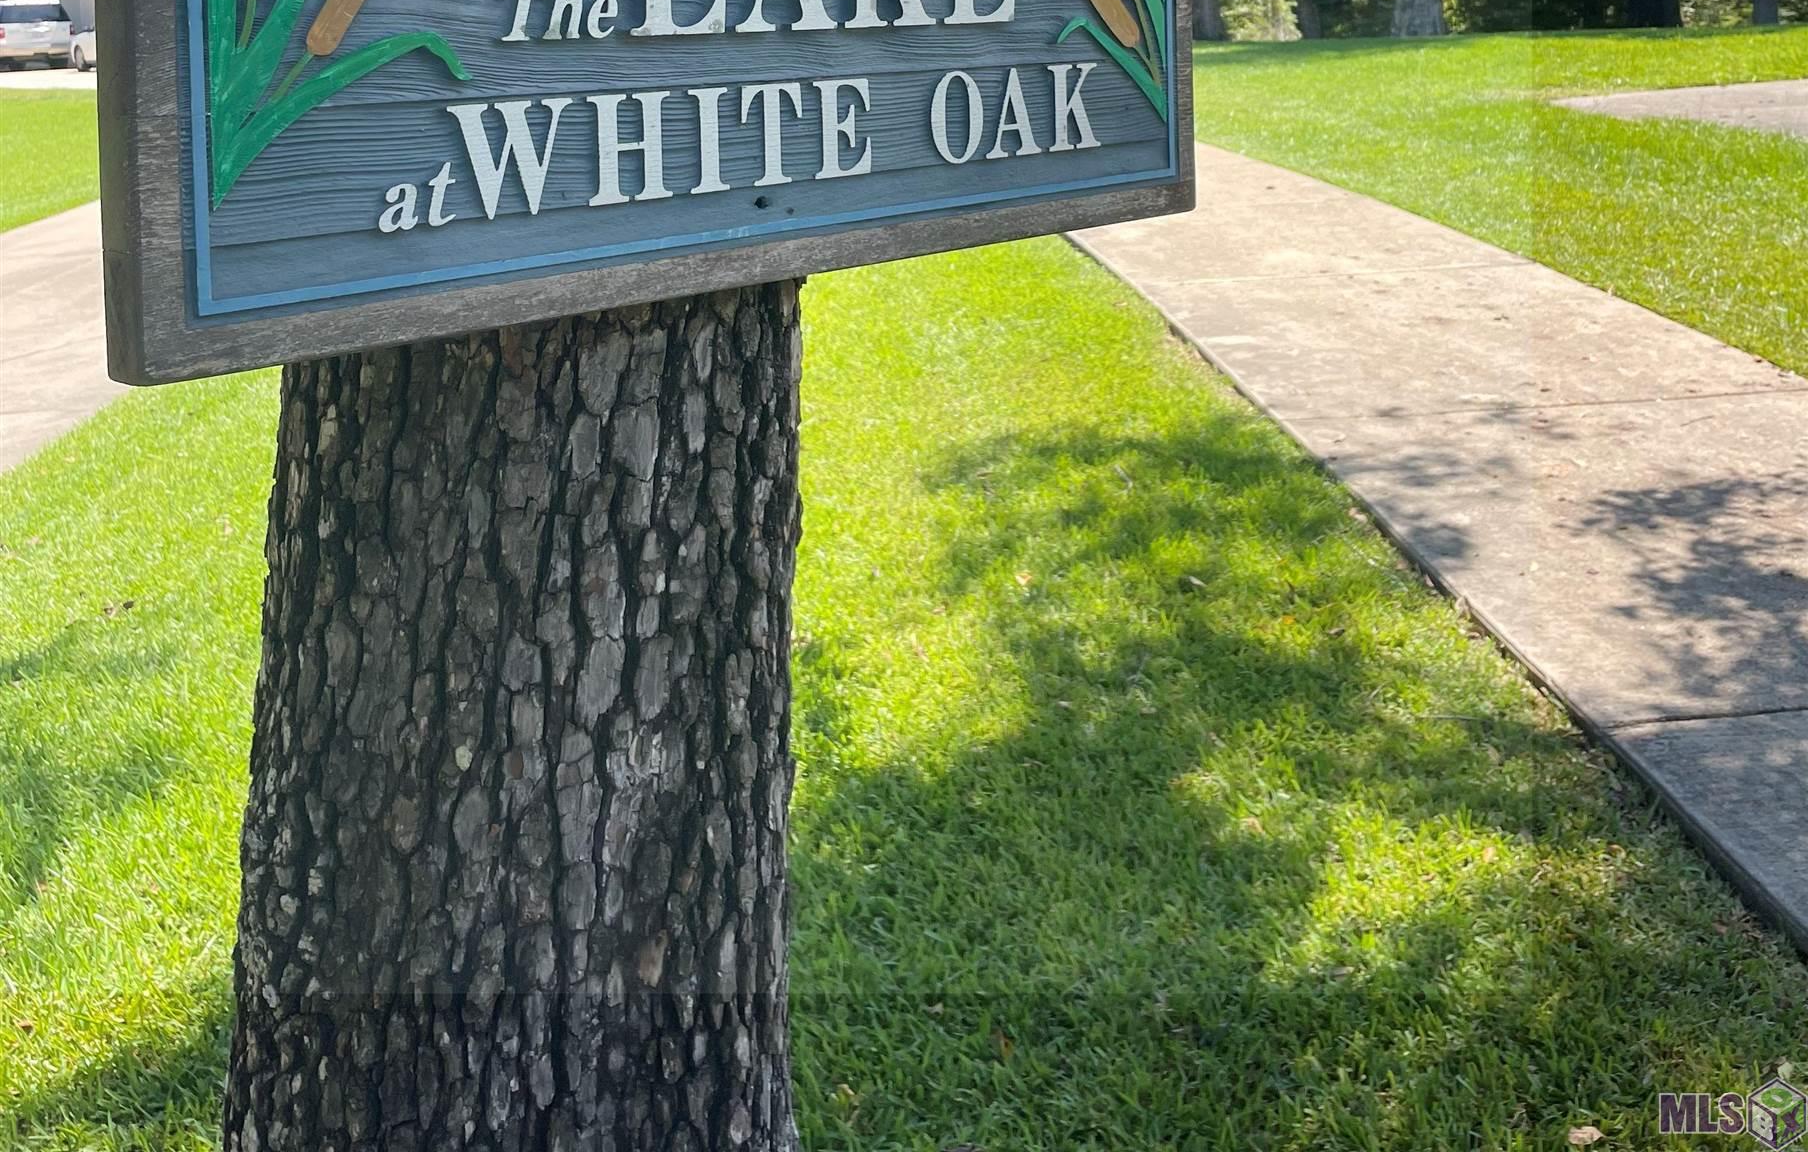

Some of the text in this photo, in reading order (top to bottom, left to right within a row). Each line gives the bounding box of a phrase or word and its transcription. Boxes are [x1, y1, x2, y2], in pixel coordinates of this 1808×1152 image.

[378, 63, 1102, 233] at WHITE OAK
